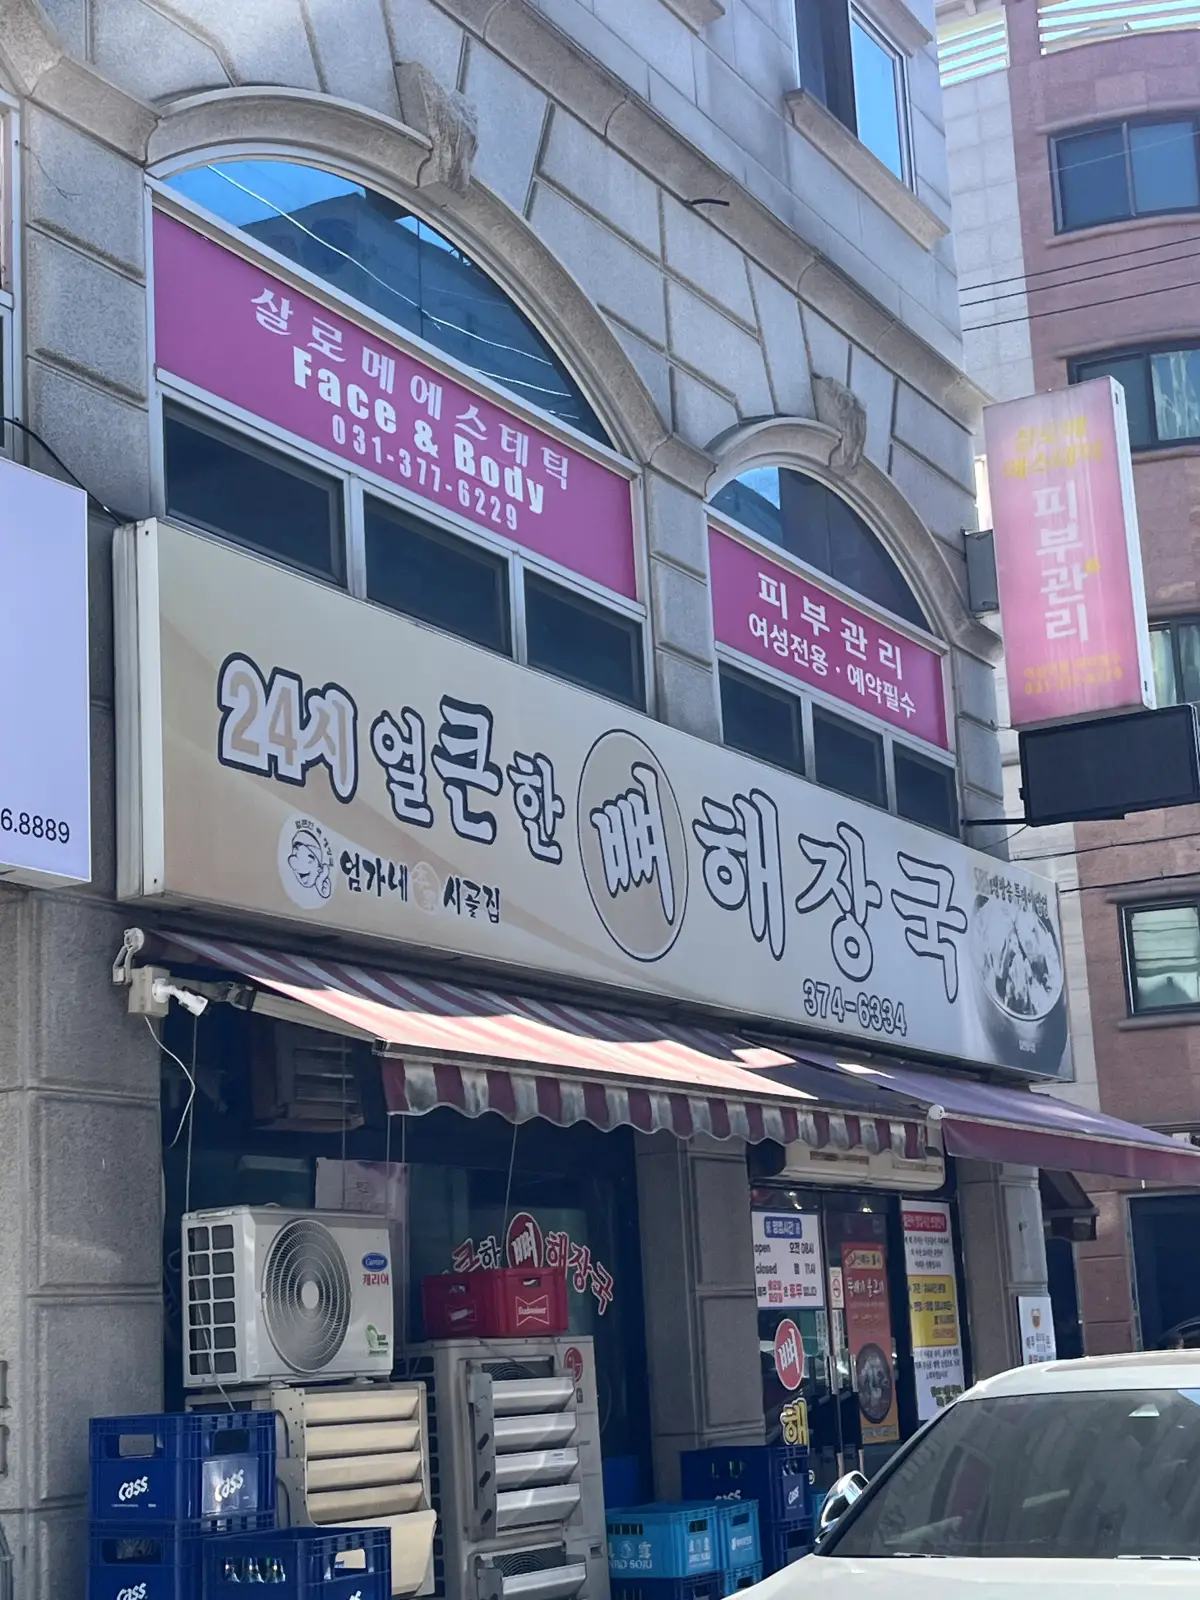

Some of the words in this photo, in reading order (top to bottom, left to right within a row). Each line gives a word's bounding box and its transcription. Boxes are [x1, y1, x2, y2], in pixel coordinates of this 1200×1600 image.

[293, 346, 397, 434] Face
[414, 420, 438, 459] &
[454, 433, 544, 514] Body
[332, 415, 517, 531] 031-377-6229
[1033, 479, 1089, 642] 피부관리
[748, 613, 829, 677] 여성전용
[847, 663, 916, 718] 예약필수
[217, 651, 359, 804] 24시
[370, 694, 565, 865] 얼큰한
[692, 788, 967, 1004] 해장국
[340, 850, 408, 902] 엄가네
[443, 875, 500, 924] 시골집
[802, 978, 908, 1037] 374-6334
[754, 1243, 771, 1256] open
[756, 1262, 778, 1275] closed
[118, 1476, 149, 1501] Cass
[214, 1469, 244, 1502] Cass
